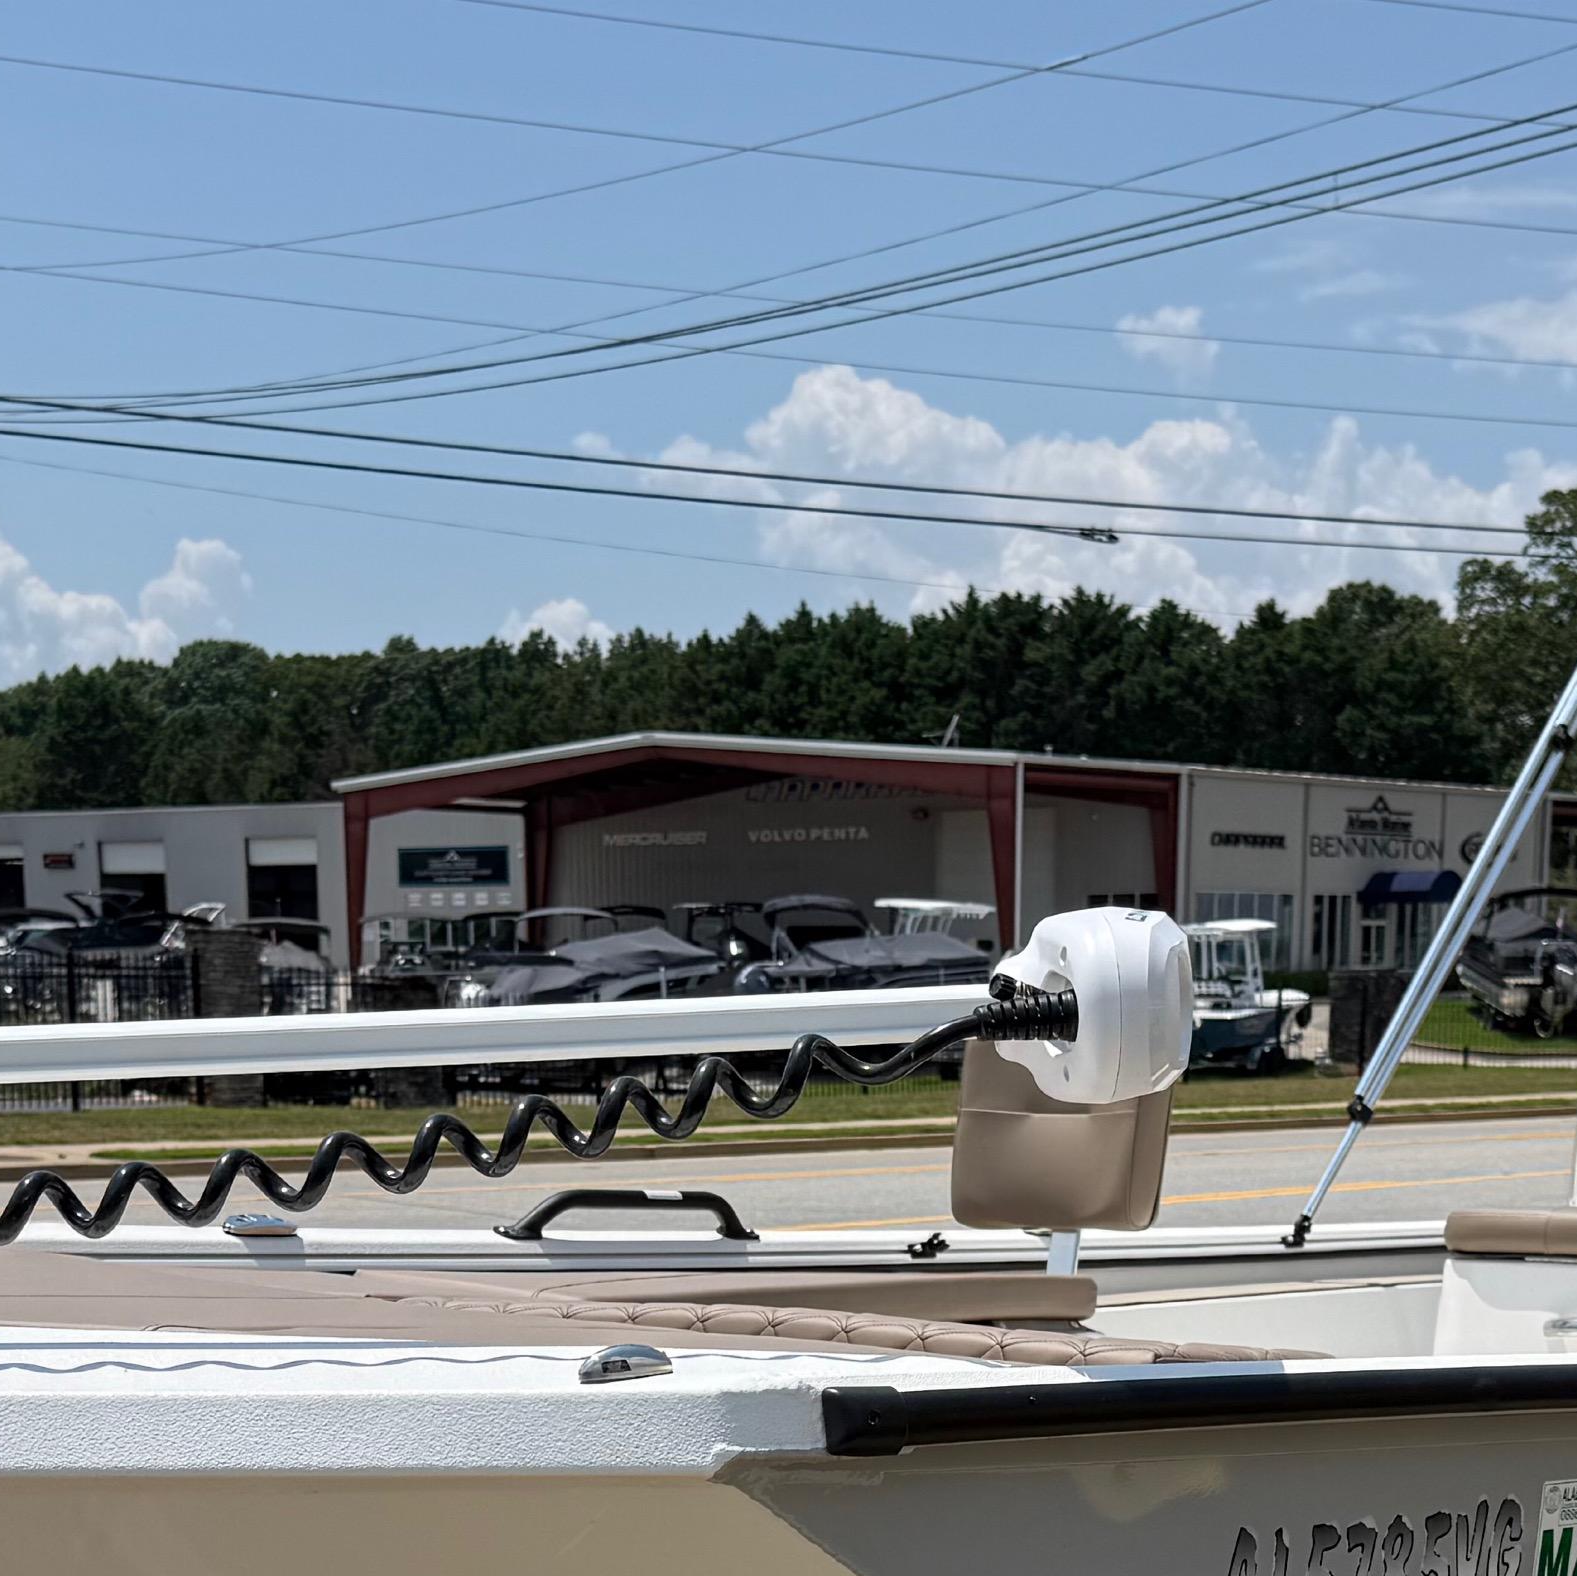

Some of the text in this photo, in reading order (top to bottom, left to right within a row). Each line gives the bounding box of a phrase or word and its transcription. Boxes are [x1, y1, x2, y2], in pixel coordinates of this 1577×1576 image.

[747, 826, 870, 843] VOLVO PENTA
[1308, 836, 1445, 861] BENNINGTON
